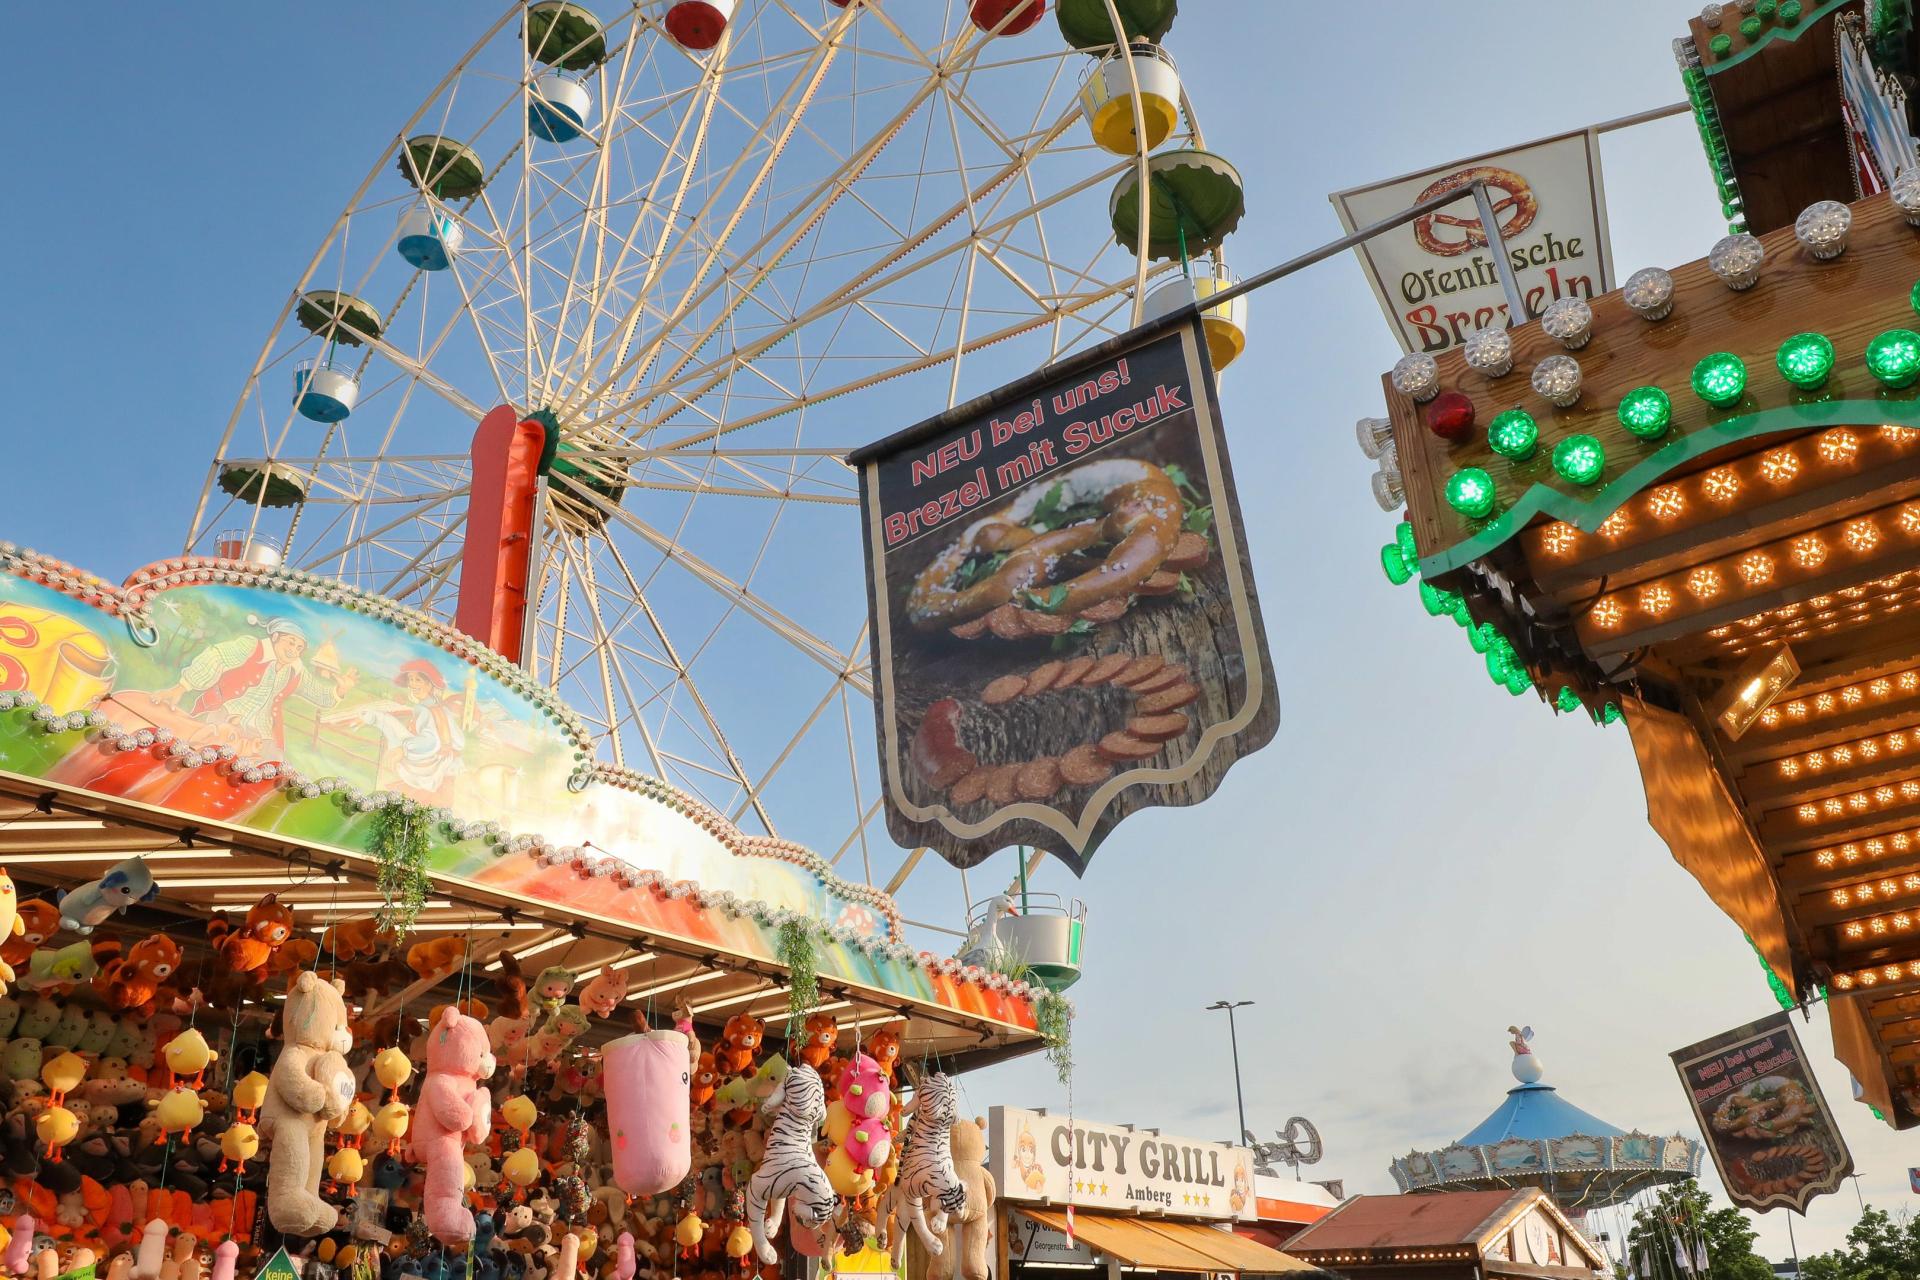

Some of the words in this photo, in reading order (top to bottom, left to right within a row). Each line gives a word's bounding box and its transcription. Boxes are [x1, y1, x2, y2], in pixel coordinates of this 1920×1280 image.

[1400, 232, 1585, 305] Ofenfrsche
[911, 428, 982, 487] NEU
[990, 399, 1045, 448] bei
[1052, 358, 1132, 413] uns!
[883, 467, 991, 547] Brezel
[996, 439, 1059, 490] mit
[1063, 384, 1187, 456] Sucuk
[1695, 1076, 1732, 1102] Brezel
[1732, 1066, 1755, 1084] mit
[1754, 1048, 1797, 1074] Sucuk
[1698, 1060, 1725, 1081] NEU
[1725, 1050, 1746, 1068] bei
[1746, 1037, 1774, 1058] uns!
[1050, 1125, 1131, 1176] CITY
[1139, 1140, 1226, 1188] GRILL
[1125, 1184, 1172, 1208] Amberg
[265, 1268, 293, 1280] keine
